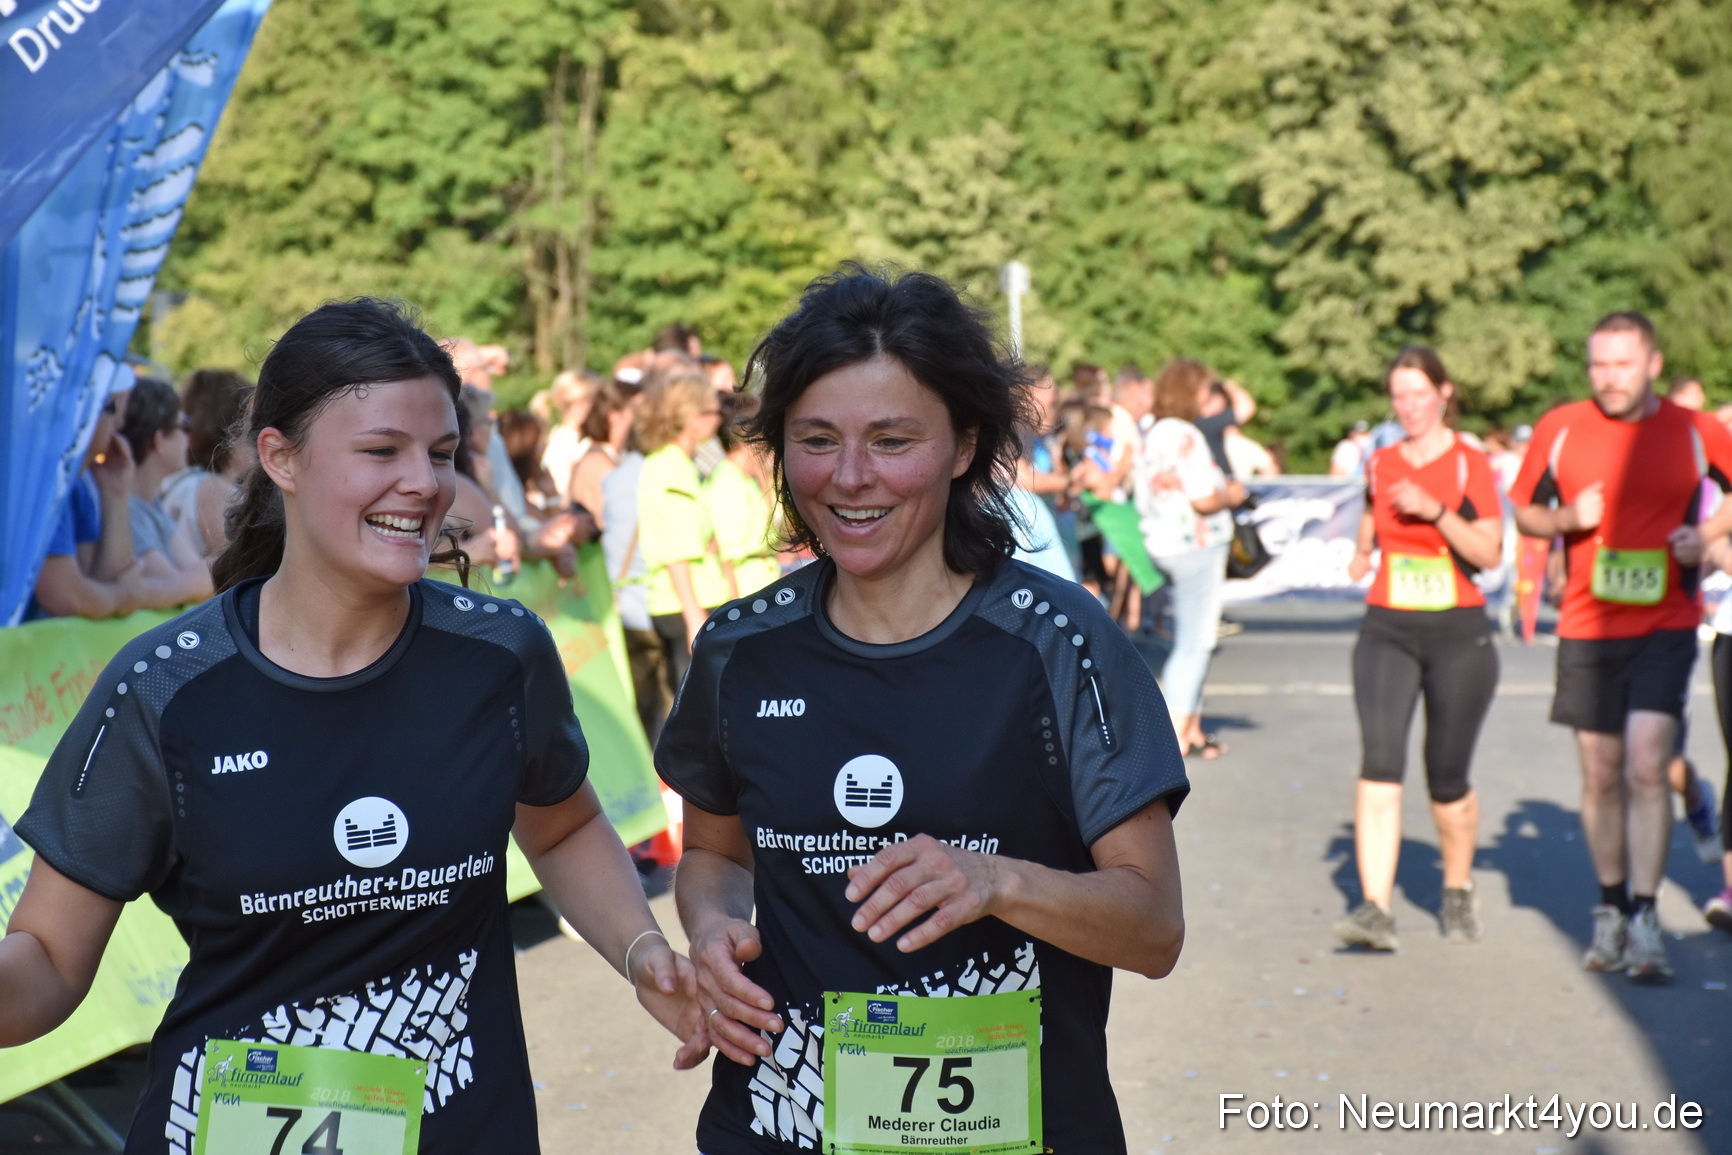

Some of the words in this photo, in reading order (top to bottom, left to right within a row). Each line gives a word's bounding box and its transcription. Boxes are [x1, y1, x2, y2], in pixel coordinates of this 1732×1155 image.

[1604, 566, 1658, 591] 1155
[756, 698, 806, 718] JAKO
[211, 750, 268, 775] JAKO
[240, 851, 495, 916] Bärnreuther+Deuerlein
[302, 889, 450, 924] SCHOTTERWERKE
[854, 1019, 927, 1037] firmenlauf
[936, 1034, 975, 1048] 2018
[231, 1067, 304, 1087] firmenlauf
[893, 1056, 975, 1114] 75
[311, 1087, 351, 1103] 2018
[266, 1106, 344, 1155] 74
[868, 1115, 936, 1132] Mederer
[940, 1115, 1001, 1132] Claudia
[901, 1134, 969, 1146] Bärnreuther
